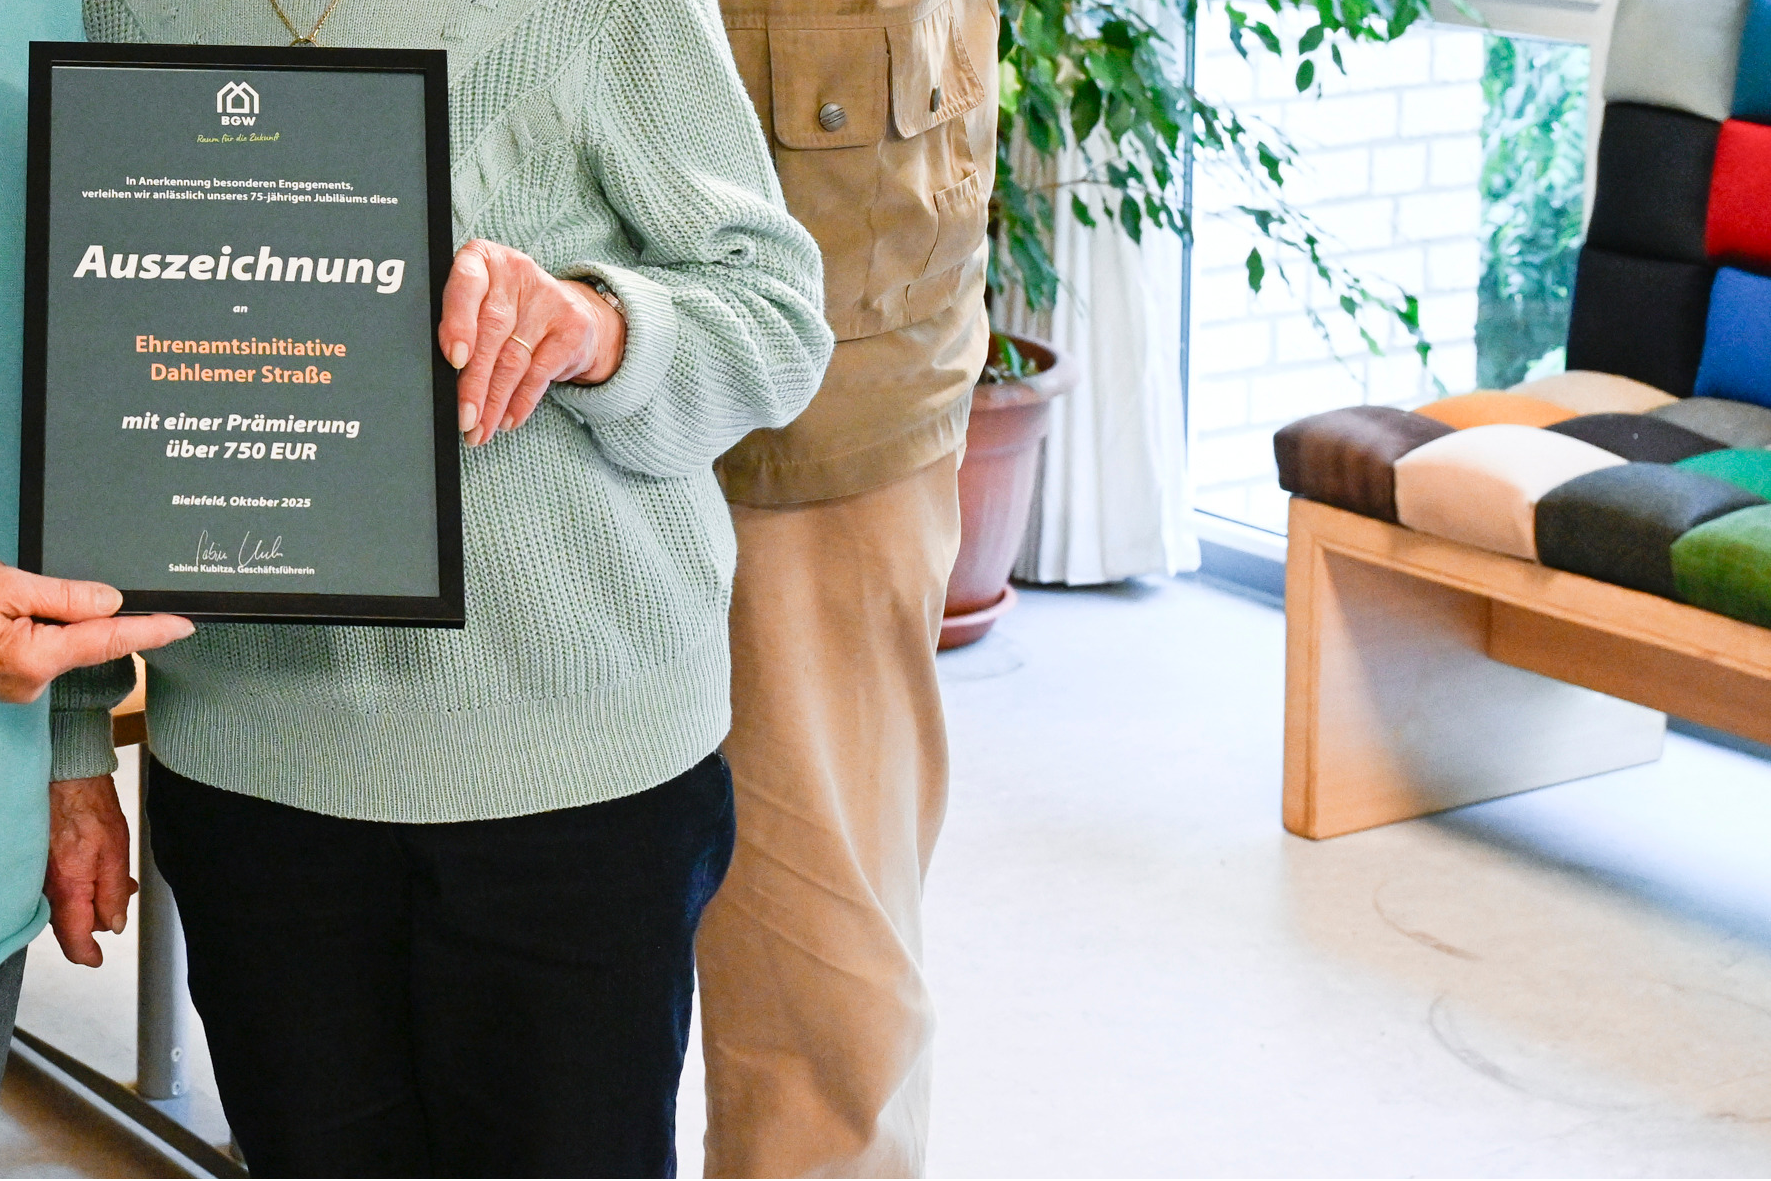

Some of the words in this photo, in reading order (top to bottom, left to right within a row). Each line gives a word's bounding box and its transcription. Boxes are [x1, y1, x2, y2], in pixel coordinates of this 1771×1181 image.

[222, 116, 255, 126] BGW
[197, 134, 220, 143] Raum
[222, 134, 234, 143] für
[249, 132, 280, 142] Zukunft
[126, 177, 136, 185] In
[139, 177, 211, 188] Anerkennung
[214, 178, 276, 187] besonderen
[279, 180, 353, 190] Engagements,
[82, 189, 131, 198] verleihen
[134, 190, 150, 198] wir
[153, 190, 204, 199] anlässlich
[251, 193, 311, 203] 75-jährigen
[314, 194, 367, 203] Jubiläums
[370, 195, 398, 204] diese
[73, 245, 405, 293] Auszeichnung
[136, 335, 346, 356] Ehrenamtsinitiative
[151, 363, 256, 382] Dahlemer
[262, 366, 331, 383] Straße
[122, 412, 159, 429] mit
[164, 413, 222, 430] einer
[227, 414, 360, 438] Prämierung
[166, 440, 219, 458] über
[224, 442, 265, 459] 750
[271, 443, 317, 460] EUR
[172, 495, 226, 507] Bielefeld,
[230, 496, 279, 507] Oktober
[281, 498, 311, 507] 2025
[168, 563, 199, 573] Sabine
[201, 563, 236, 575] Kubitza,
[237, 564, 315, 575] Geschäftsführerin
